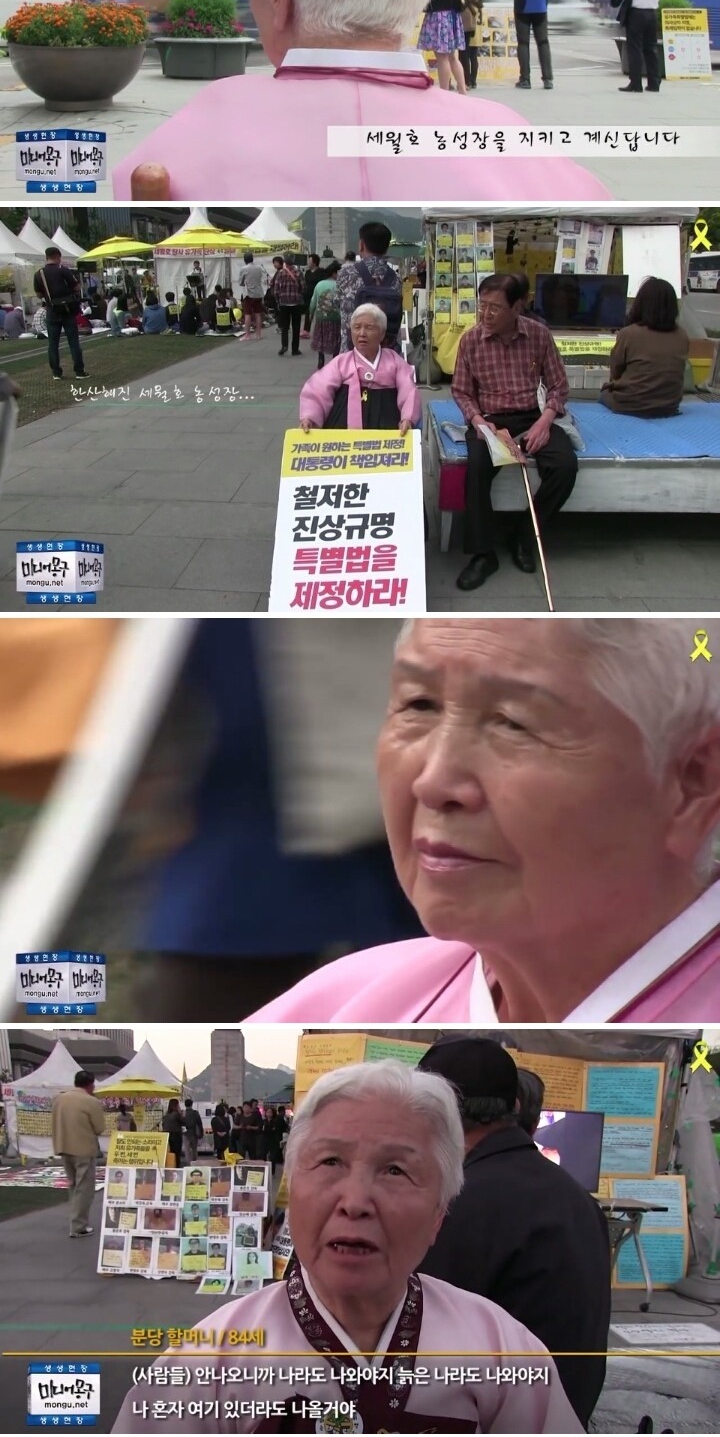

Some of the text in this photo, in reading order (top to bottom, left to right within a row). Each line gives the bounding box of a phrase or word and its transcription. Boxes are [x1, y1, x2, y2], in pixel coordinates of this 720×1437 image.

[291, 443, 320, 453] 가족이
[322, 442, 350, 452] 원하는
[353, 440, 381, 451] 특별법
[291, 453, 409, 471] 대통령이 책임져라!
[293, 483, 370, 510] 철저한
[292, 512, 395, 542] 진상규명
[293, 544, 397, 575] 특별법을
[290, 578, 408, 610] 제정하라!
